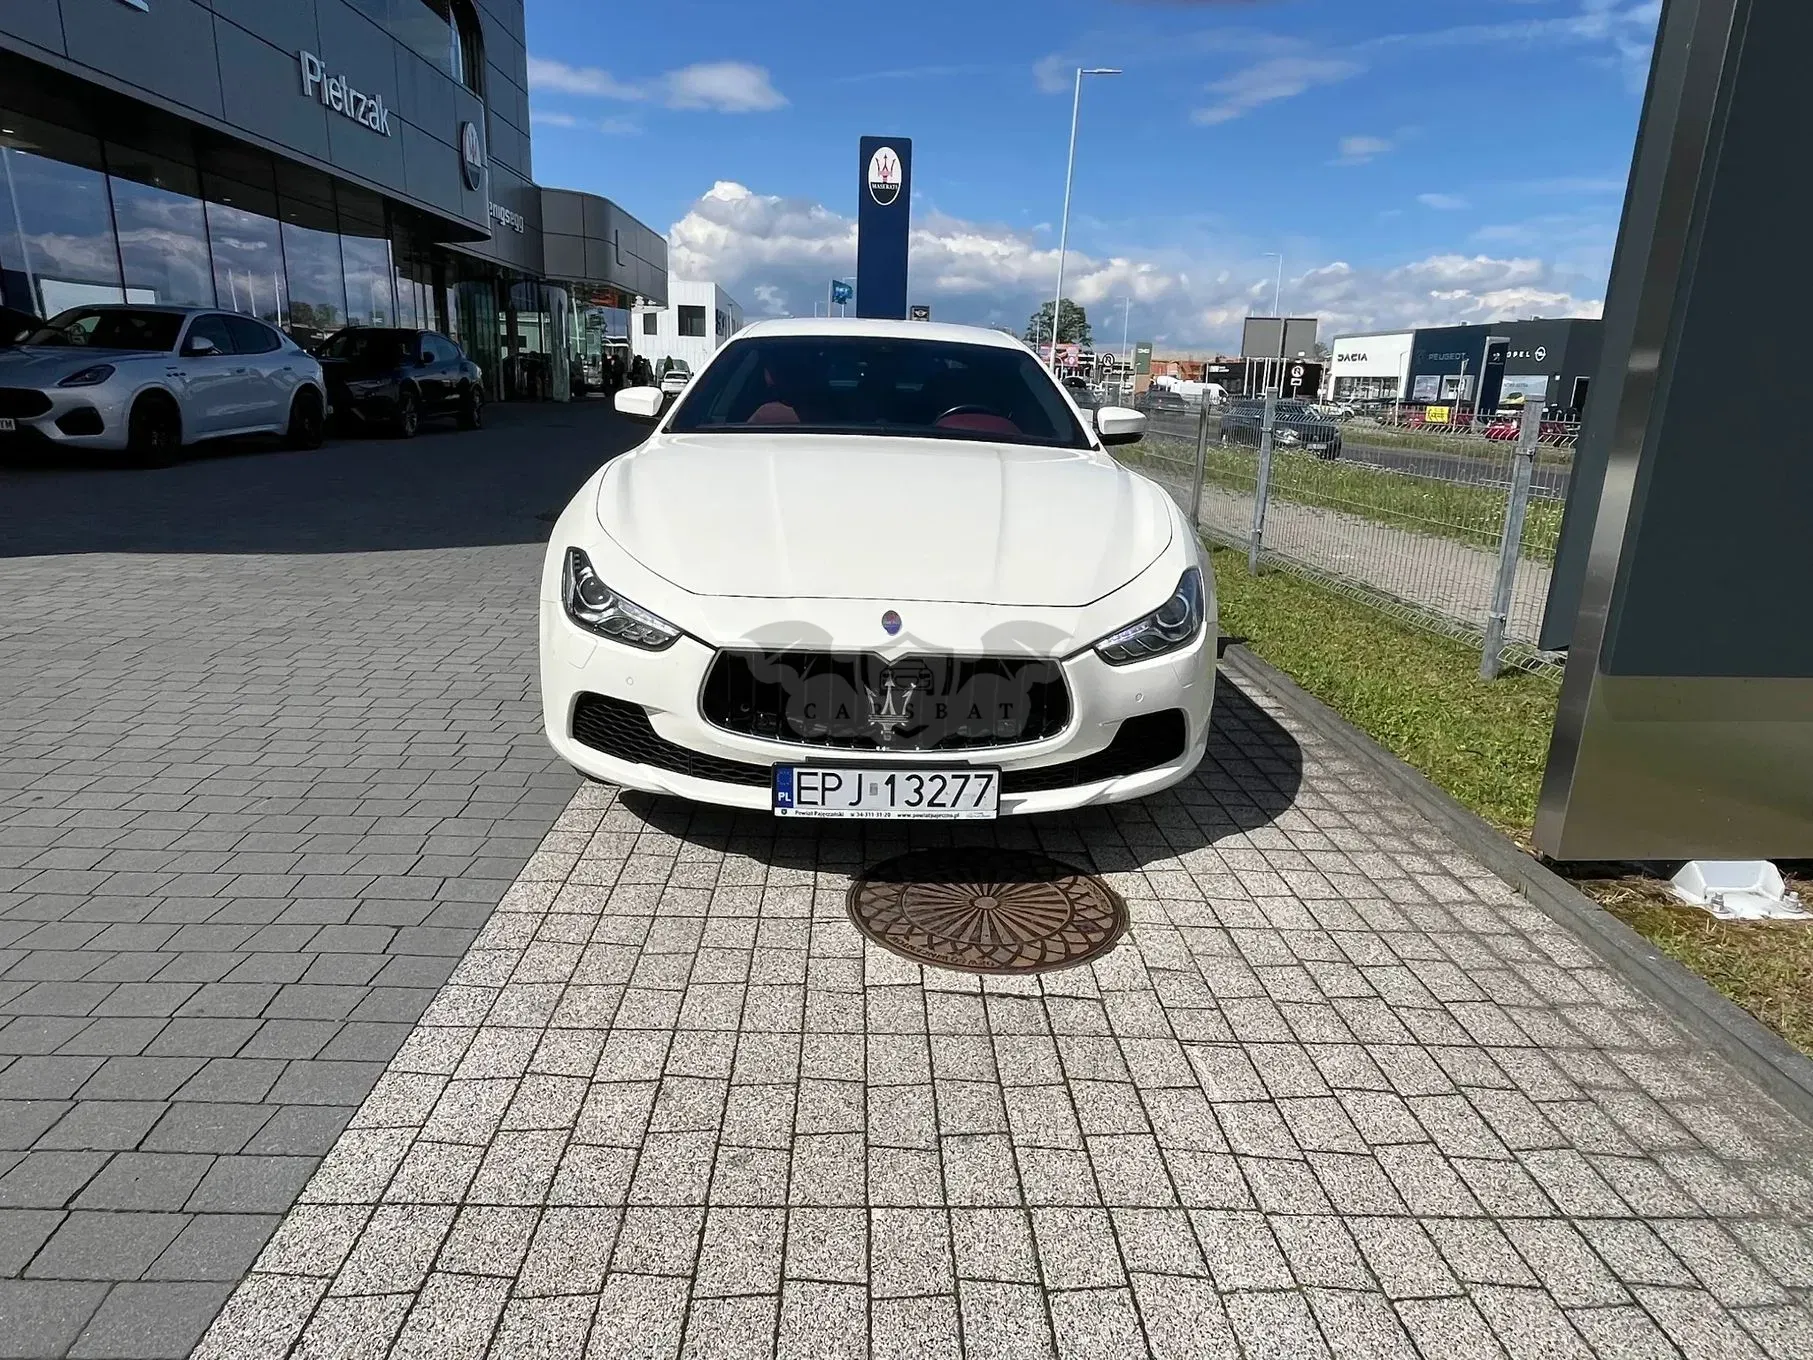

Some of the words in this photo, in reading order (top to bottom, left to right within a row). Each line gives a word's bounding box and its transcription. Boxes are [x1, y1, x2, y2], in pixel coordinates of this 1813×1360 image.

[298, 50, 392, 137] Pietrzak
[1338, 353, 1368, 362] DACIA
[1428, 352, 1466, 360] PEUGEOT
[796, 771, 863, 806] EPJ
[884, 773, 994, 808] 13277
[778, 792, 792, 802] PL
